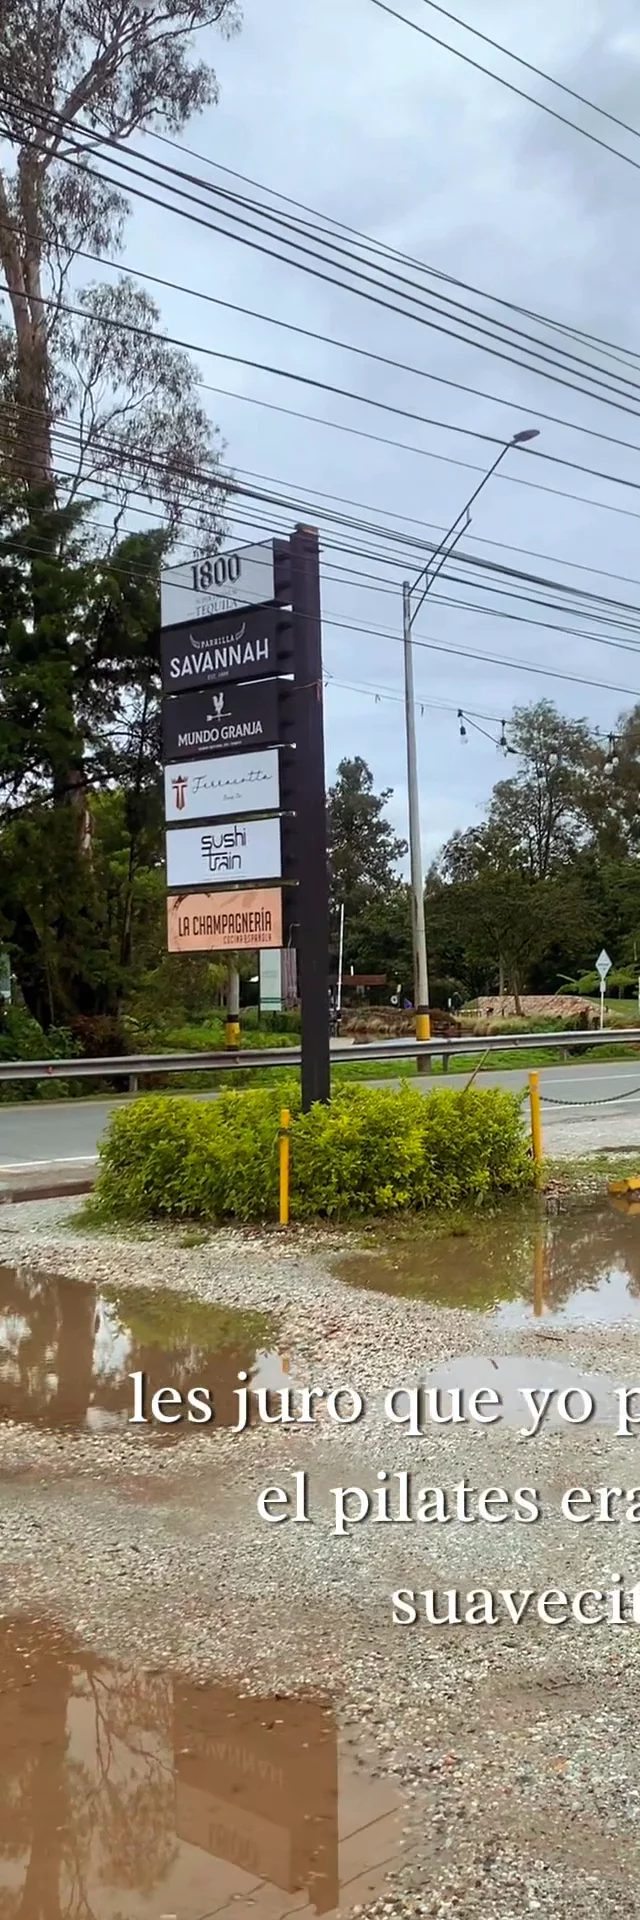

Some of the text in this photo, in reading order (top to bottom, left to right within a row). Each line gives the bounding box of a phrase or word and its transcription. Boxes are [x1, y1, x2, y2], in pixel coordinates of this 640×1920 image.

[191, 553, 241, 592] 1800
[196, 598, 238, 617] TEQUILA
[170, 638, 269, 678] SAVANNAH
[178, 728, 219, 747] MUNDO
[220, 720, 263, 740] GRANJA
[192, 771, 272, 793] Terracotta
[201, 825, 246, 850] sushi
[178, 906, 272, 936] LA CHAMPAGNERÍA
